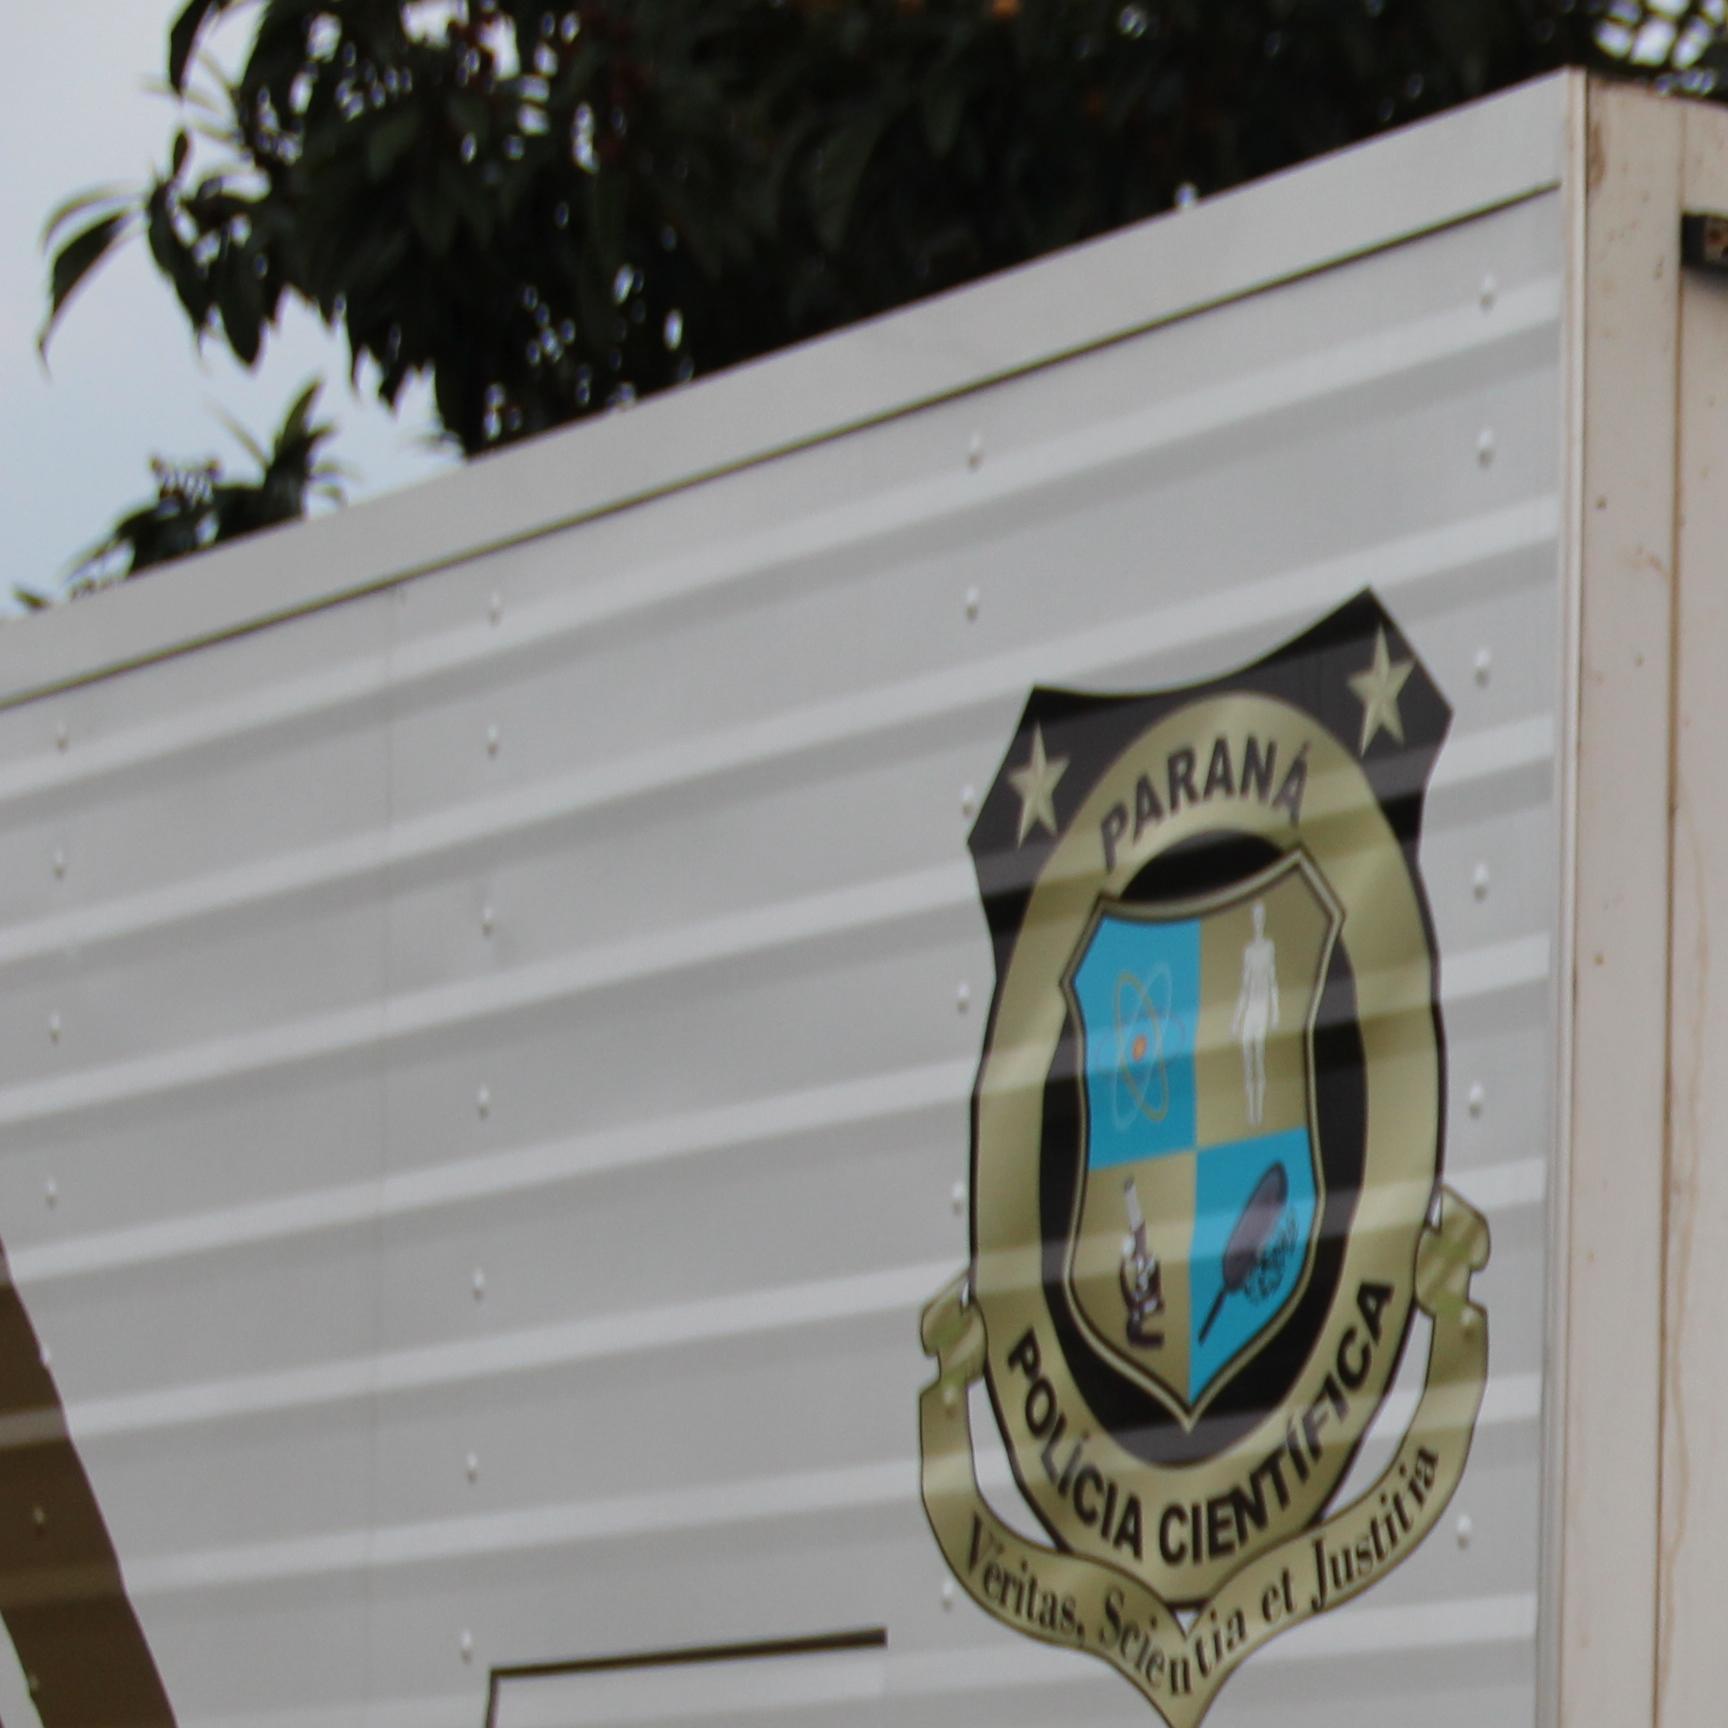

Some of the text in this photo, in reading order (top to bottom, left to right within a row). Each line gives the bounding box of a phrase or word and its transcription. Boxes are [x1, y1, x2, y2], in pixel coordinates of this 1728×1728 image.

[1097, 734, 1310, 874] PARANÁ
[1007, 1281, 1394, 1567] POLÍCIA CIENTÍFICA
[968, 1446, 1440, 1697] Veritas, Scientia et Justitia
